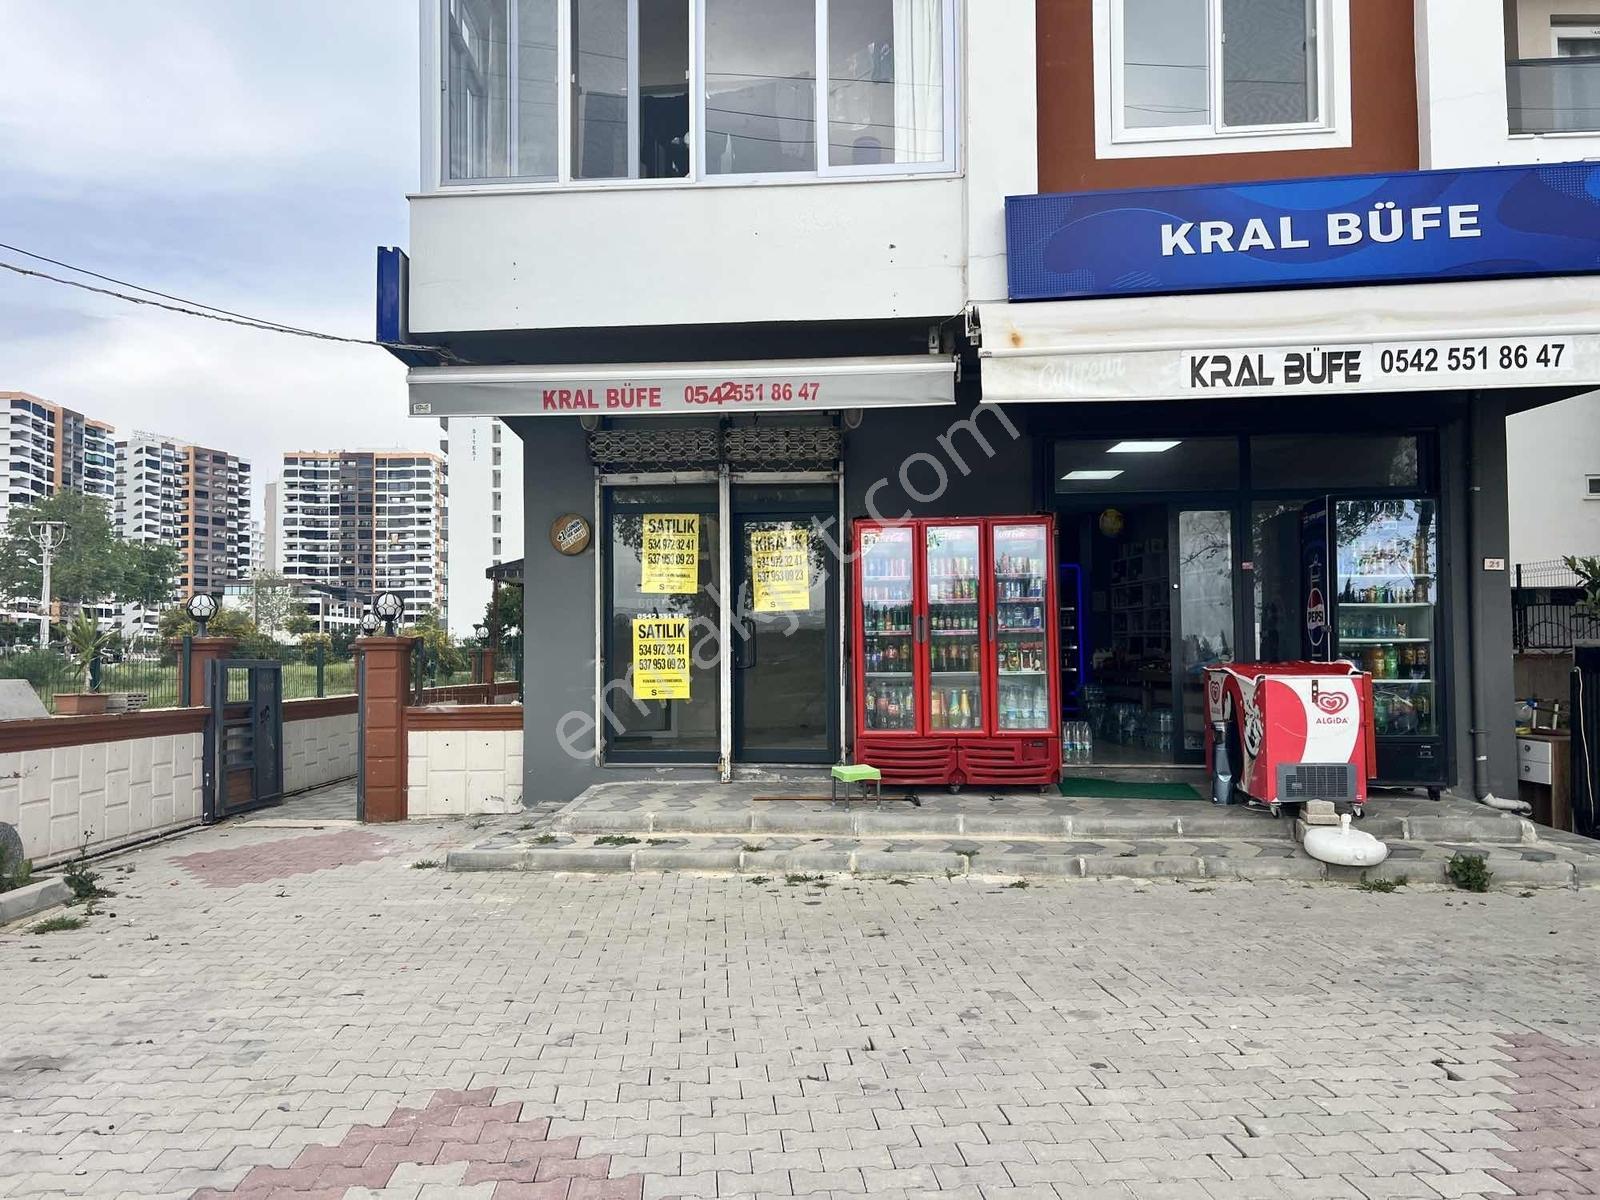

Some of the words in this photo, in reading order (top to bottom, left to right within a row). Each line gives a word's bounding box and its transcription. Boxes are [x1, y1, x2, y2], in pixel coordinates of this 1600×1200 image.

[1161, 216, 1310, 256] KRAL
[1327, 201, 1482, 246] BÜFE
[1380, 348, 1439, 373] 0542
[1447, 346, 1489, 370] 551
[1500, 345, 1528, 369] 86
[1536, 344, 1565, 368] 47
[1191, 354, 1275, 388] KRAL
[1284, 347, 1362, 385] BÜFE
[542, 388, 600, 410] KRAL
[606, 383, 661, 408] BÜFE
[771, 383, 793, 401] 86
[798, 382, 820, 400] 47
[648, 518, 695, 534] SATILIK
[648, 538, 661, 551] 534
[677, 538, 685, 551] 32
[686, 538, 694, 551] 41
[647, 553, 660, 565] 537
[676, 553, 685, 565] 09
[686, 553, 695, 565] 23
[771, 570, 784, 582] 953
[796, 569, 804, 581] 23
[1308, 610, 1325, 624] PEPSI
[638, 624, 686, 639] SATILIK
[639, 644, 652, 656] 534
[653, 644, 666, 656] 972
[667, 644, 676, 655] 32
[677, 644, 685, 655] 41
[639, 659, 652, 671] 537
[653, 659, 666, 670] 953
[667, 659, 676, 670] 09
[677, 658, 686, 669] 23
